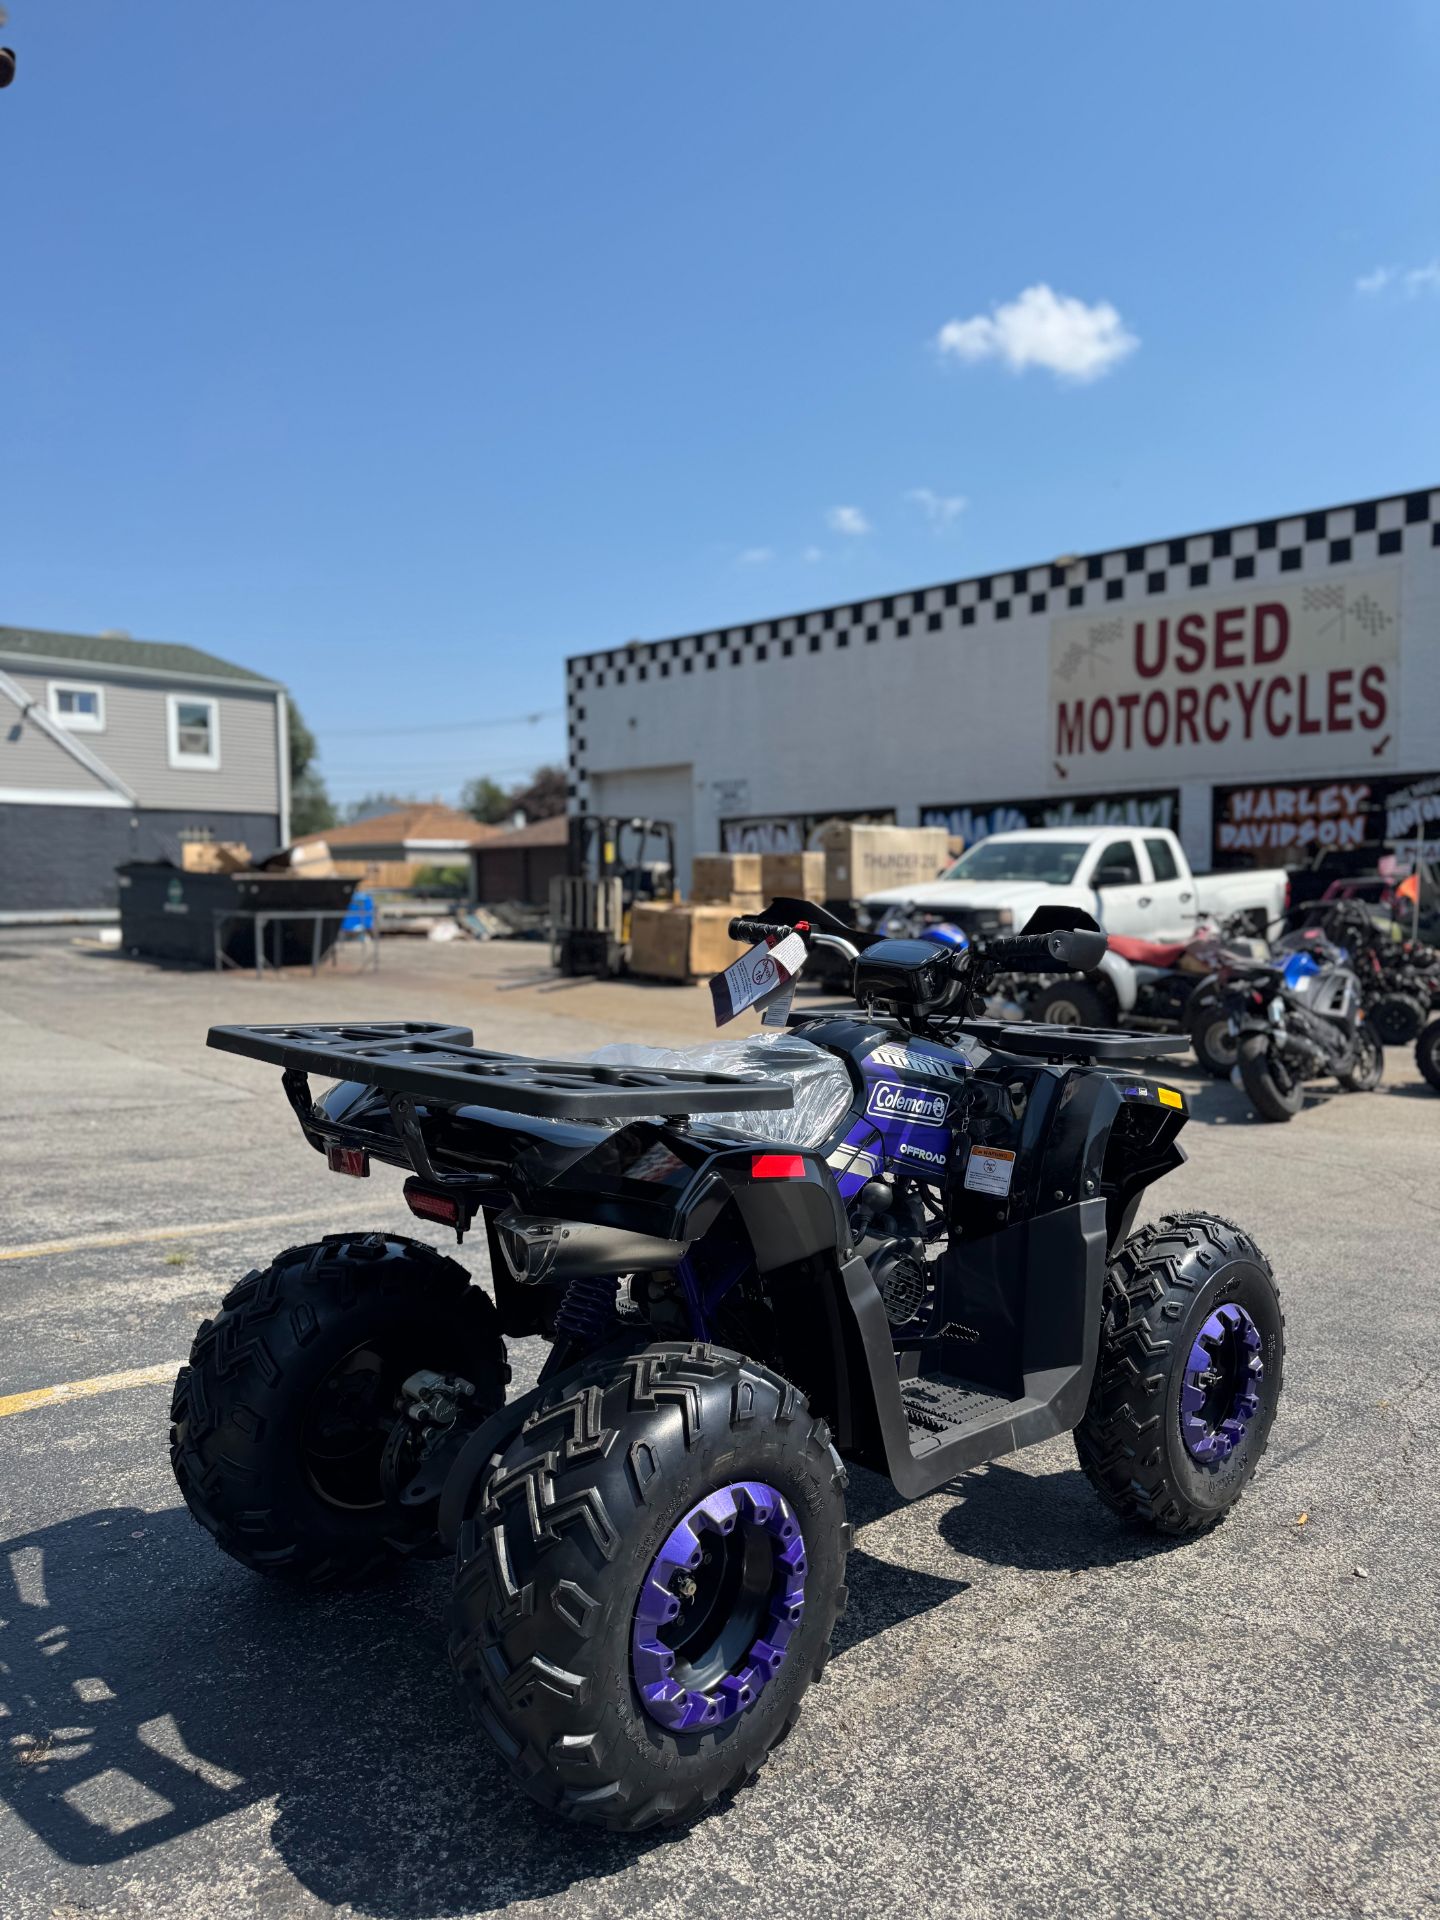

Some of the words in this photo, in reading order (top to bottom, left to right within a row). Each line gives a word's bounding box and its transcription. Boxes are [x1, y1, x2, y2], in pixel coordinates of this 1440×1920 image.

[1134, 601, 1291, 679] USED
[1056, 666, 1388, 756] MOTORCYCLES
[1231, 783, 1371, 822] HARLEY
[1218, 815, 1366, 849] DAVIDSON
[877, 1086, 933, 1115] Coleman
[900, 1143, 947, 1165] OFFROAD
